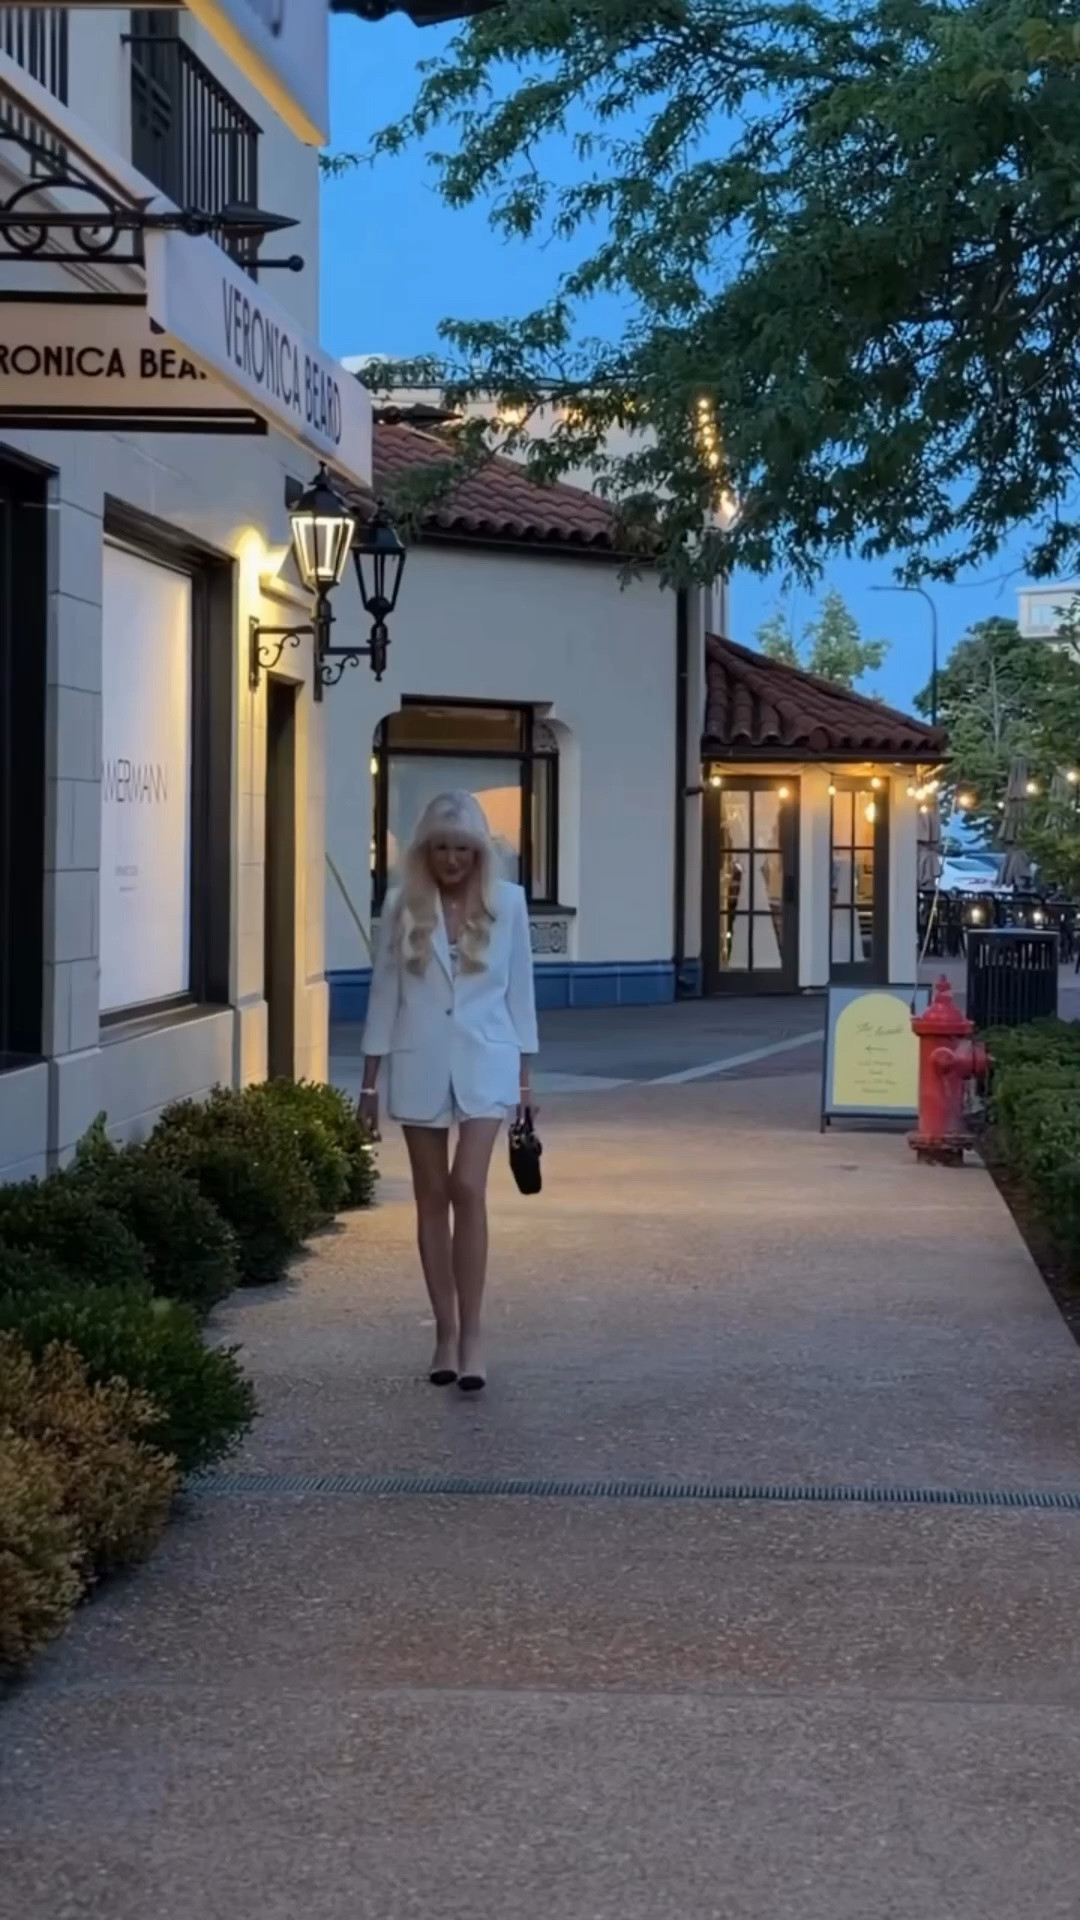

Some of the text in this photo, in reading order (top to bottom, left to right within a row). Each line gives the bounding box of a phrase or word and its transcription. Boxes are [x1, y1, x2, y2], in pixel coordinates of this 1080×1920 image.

[139, 347, 208, 380] BEA
[222, 277, 342, 445] VERONICA BEARD
